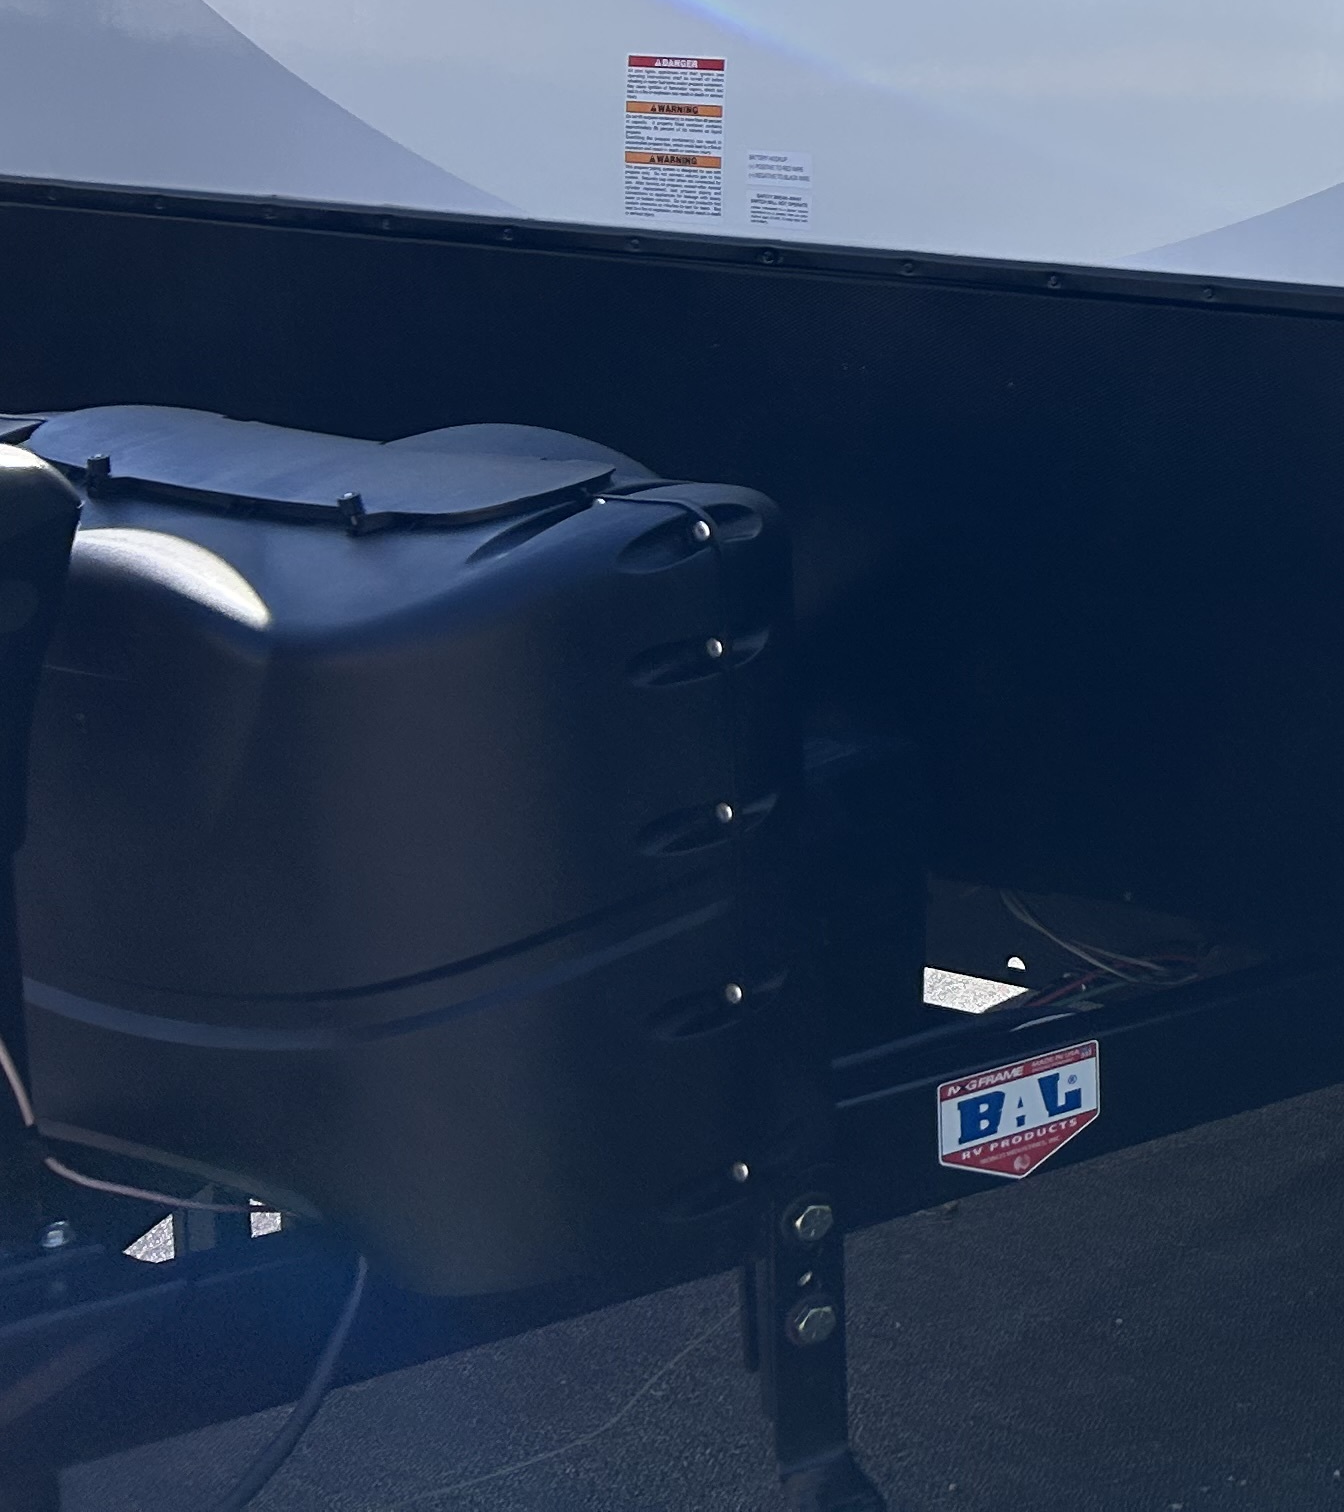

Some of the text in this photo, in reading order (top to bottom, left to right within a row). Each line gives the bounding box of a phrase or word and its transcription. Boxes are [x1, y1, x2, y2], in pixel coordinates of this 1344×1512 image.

[661, 59, 699, 69] DANGER
[657, 104, 699, 115] WARNING
[656, 155, 698, 165] WARNING
[957, 1072, 1082, 1146] BAL
[961, 1147, 983, 1161] RV
[989, 1117, 1078, 1152] PRODUCTS
